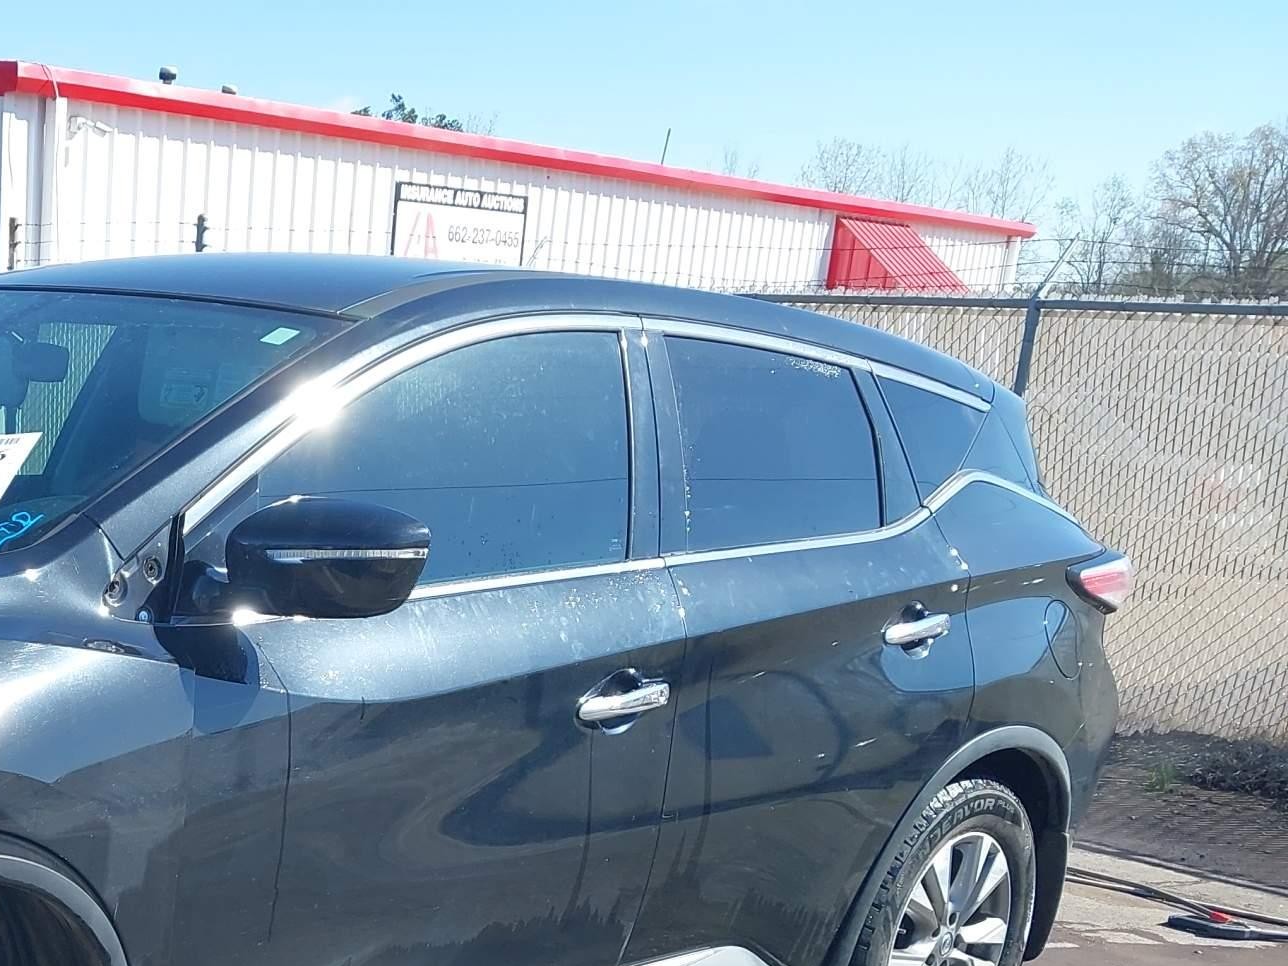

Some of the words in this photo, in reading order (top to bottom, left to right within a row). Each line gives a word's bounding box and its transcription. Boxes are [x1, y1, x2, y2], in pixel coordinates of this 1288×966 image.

[399, 183, 455, 206] INSURANCE
[455, 190, 481, 208] AUTO
[481, 193, 525, 213] AUCTIONS
[447, 224, 520, 248] 662-237-0455
